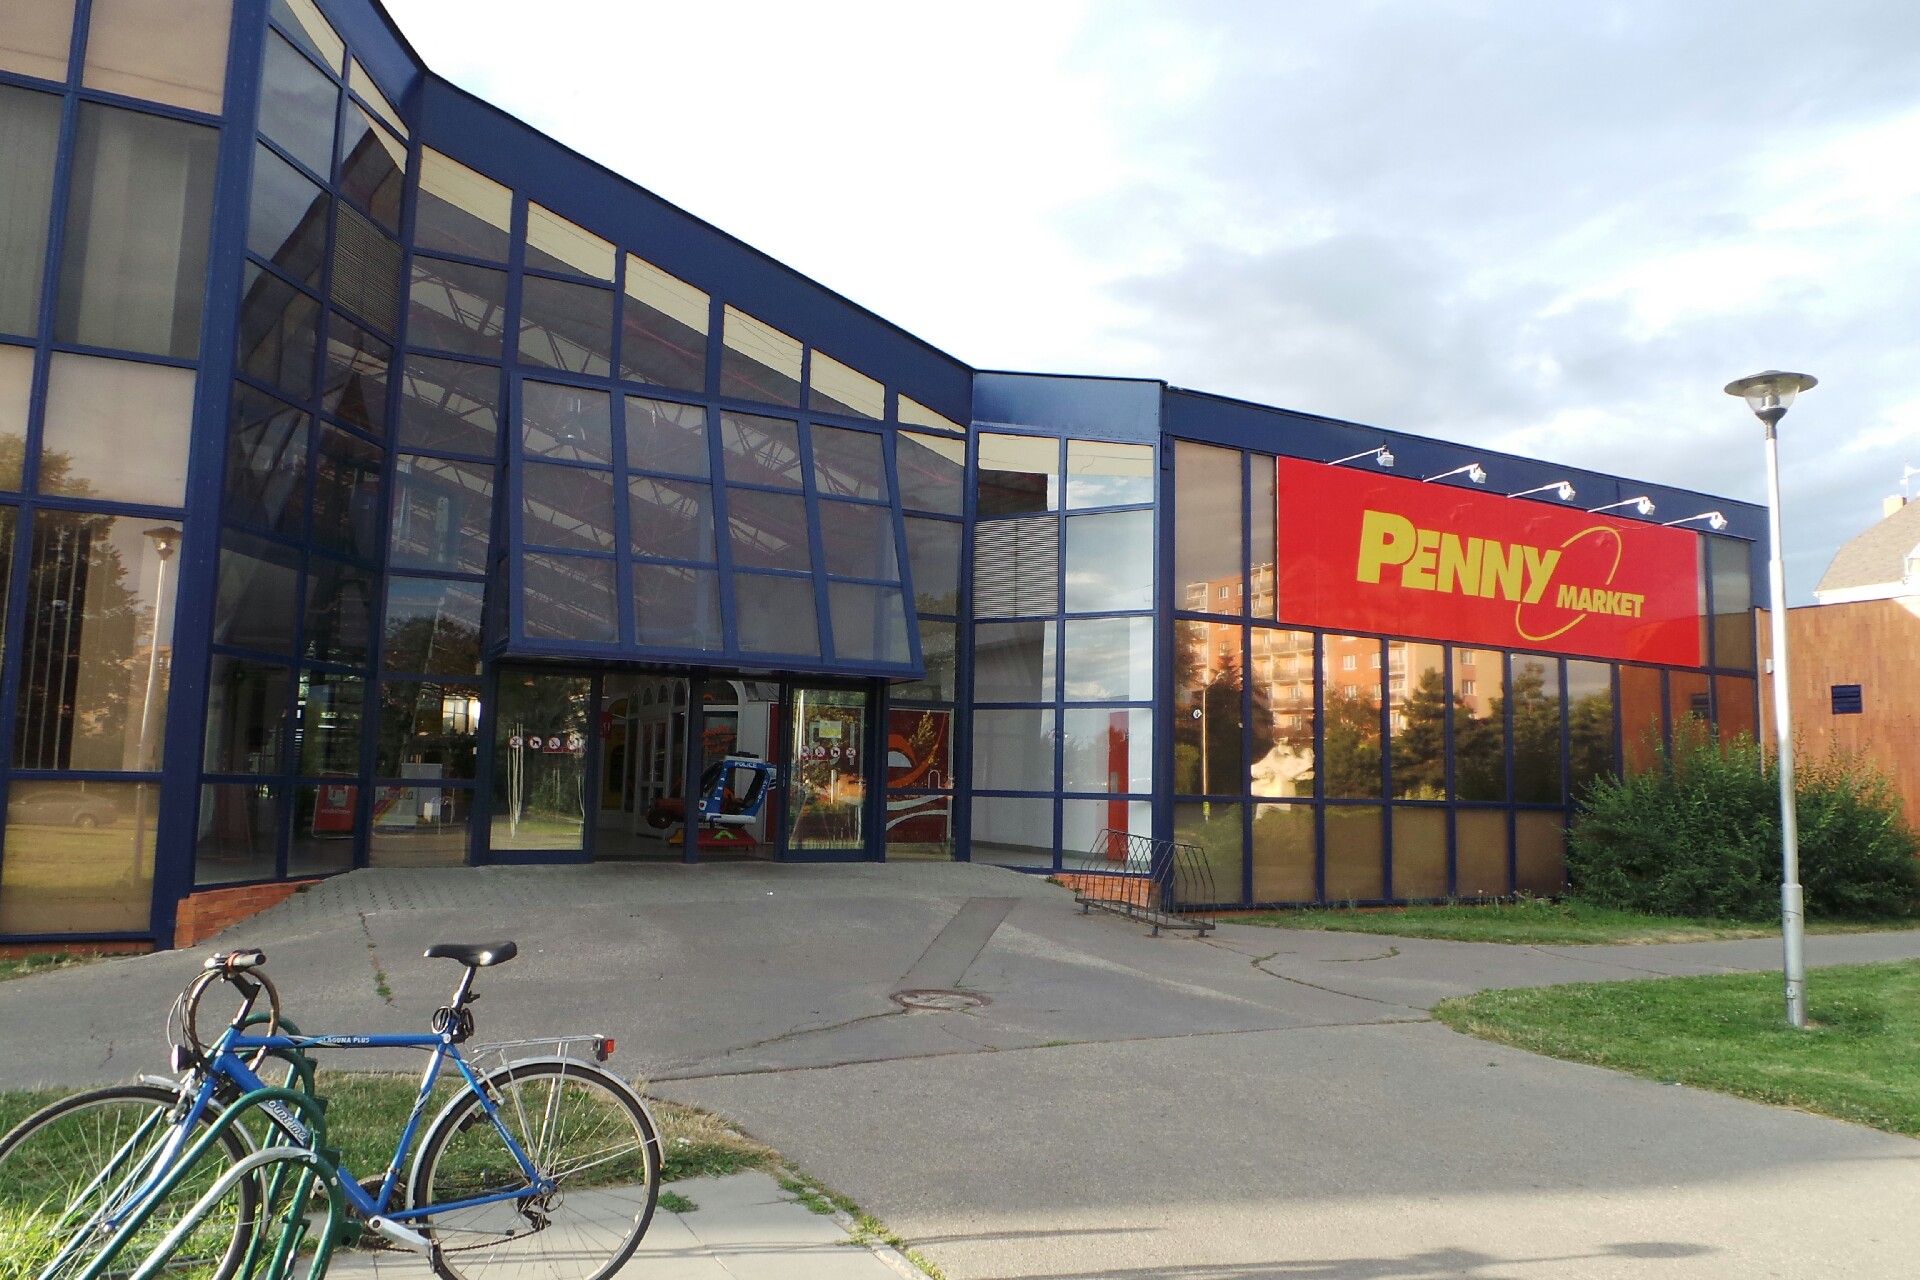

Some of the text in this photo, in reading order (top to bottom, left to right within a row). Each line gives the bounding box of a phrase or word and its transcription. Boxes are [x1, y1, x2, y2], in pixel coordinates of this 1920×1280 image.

[1356, 509, 1645, 618] PENNY MARKET
[734, 761, 757, 769] POLICE
[323, 1036, 370, 1044] LAGUNA PLUS
